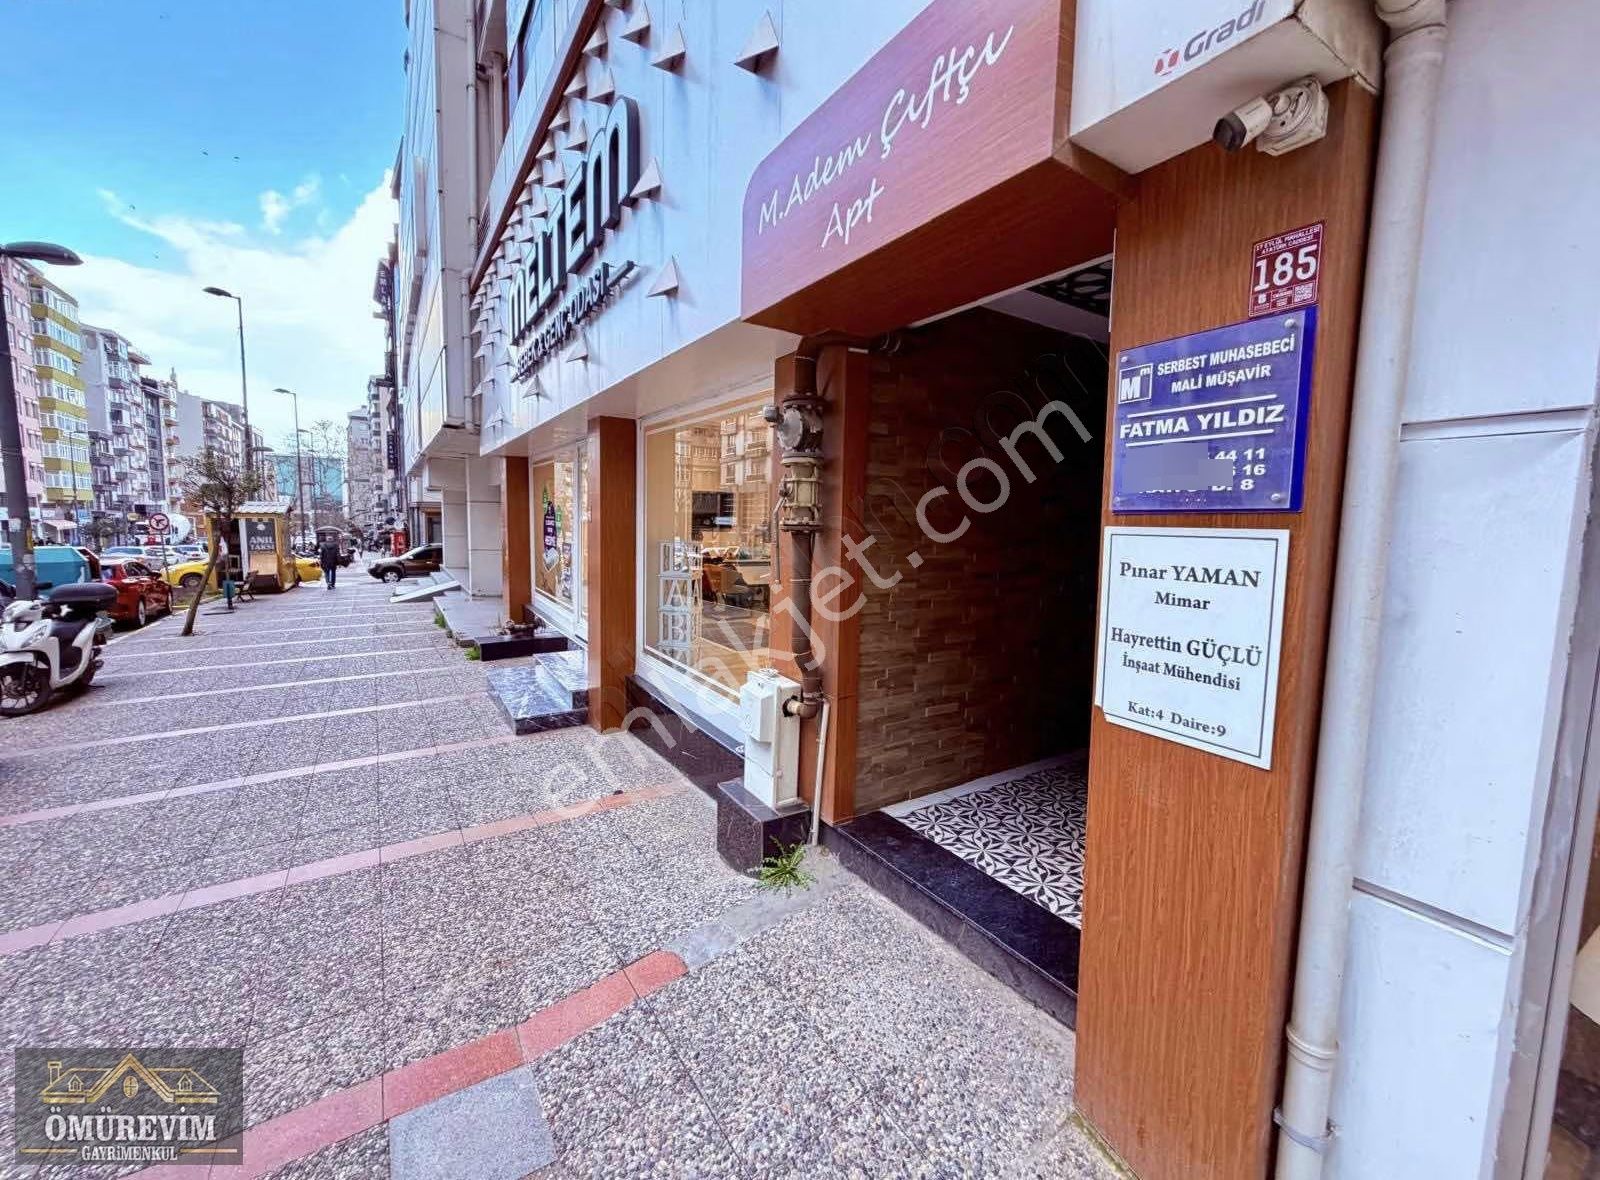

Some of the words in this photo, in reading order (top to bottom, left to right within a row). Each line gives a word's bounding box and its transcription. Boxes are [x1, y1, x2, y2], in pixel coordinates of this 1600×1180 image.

[758, 132, 871, 235] M.Adem
[821, 178, 884, 248] Apt
[1254, 244, 1317, 292] 185
[1157, 354, 1206, 376] SERBEST
[1209, 334, 1295, 366] MUHASEBECİ
[1171, 374, 1202, 394] MALİ
[1205, 363, 1272, 389] MÜŞAVİR
[1119, 416, 1190, 439] FATMA
[1197, 404, 1285, 430] YILDIZ
[1242, 464, 1266, 476] 16
[1243, 447, 1265, 460] 11
[1240, 478, 1255, 491] 8
[1119, 561, 1167, 581] Pınar
[1171, 565, 1262, 588] YAMAN
[1154, 591, 1211, 611] Mimar
[1111, 627, 1182, 652] Hayrettin
[1186, 637, 1263, 667] GÜÇLÜ
[1122, 651, 1161, 675] İnşaat
[1163, 662, 1241, 691] Mühendisi
[1127, 700, 1165, 721] Kat:4
[1170, 711, 1227, 738] Daire:9
